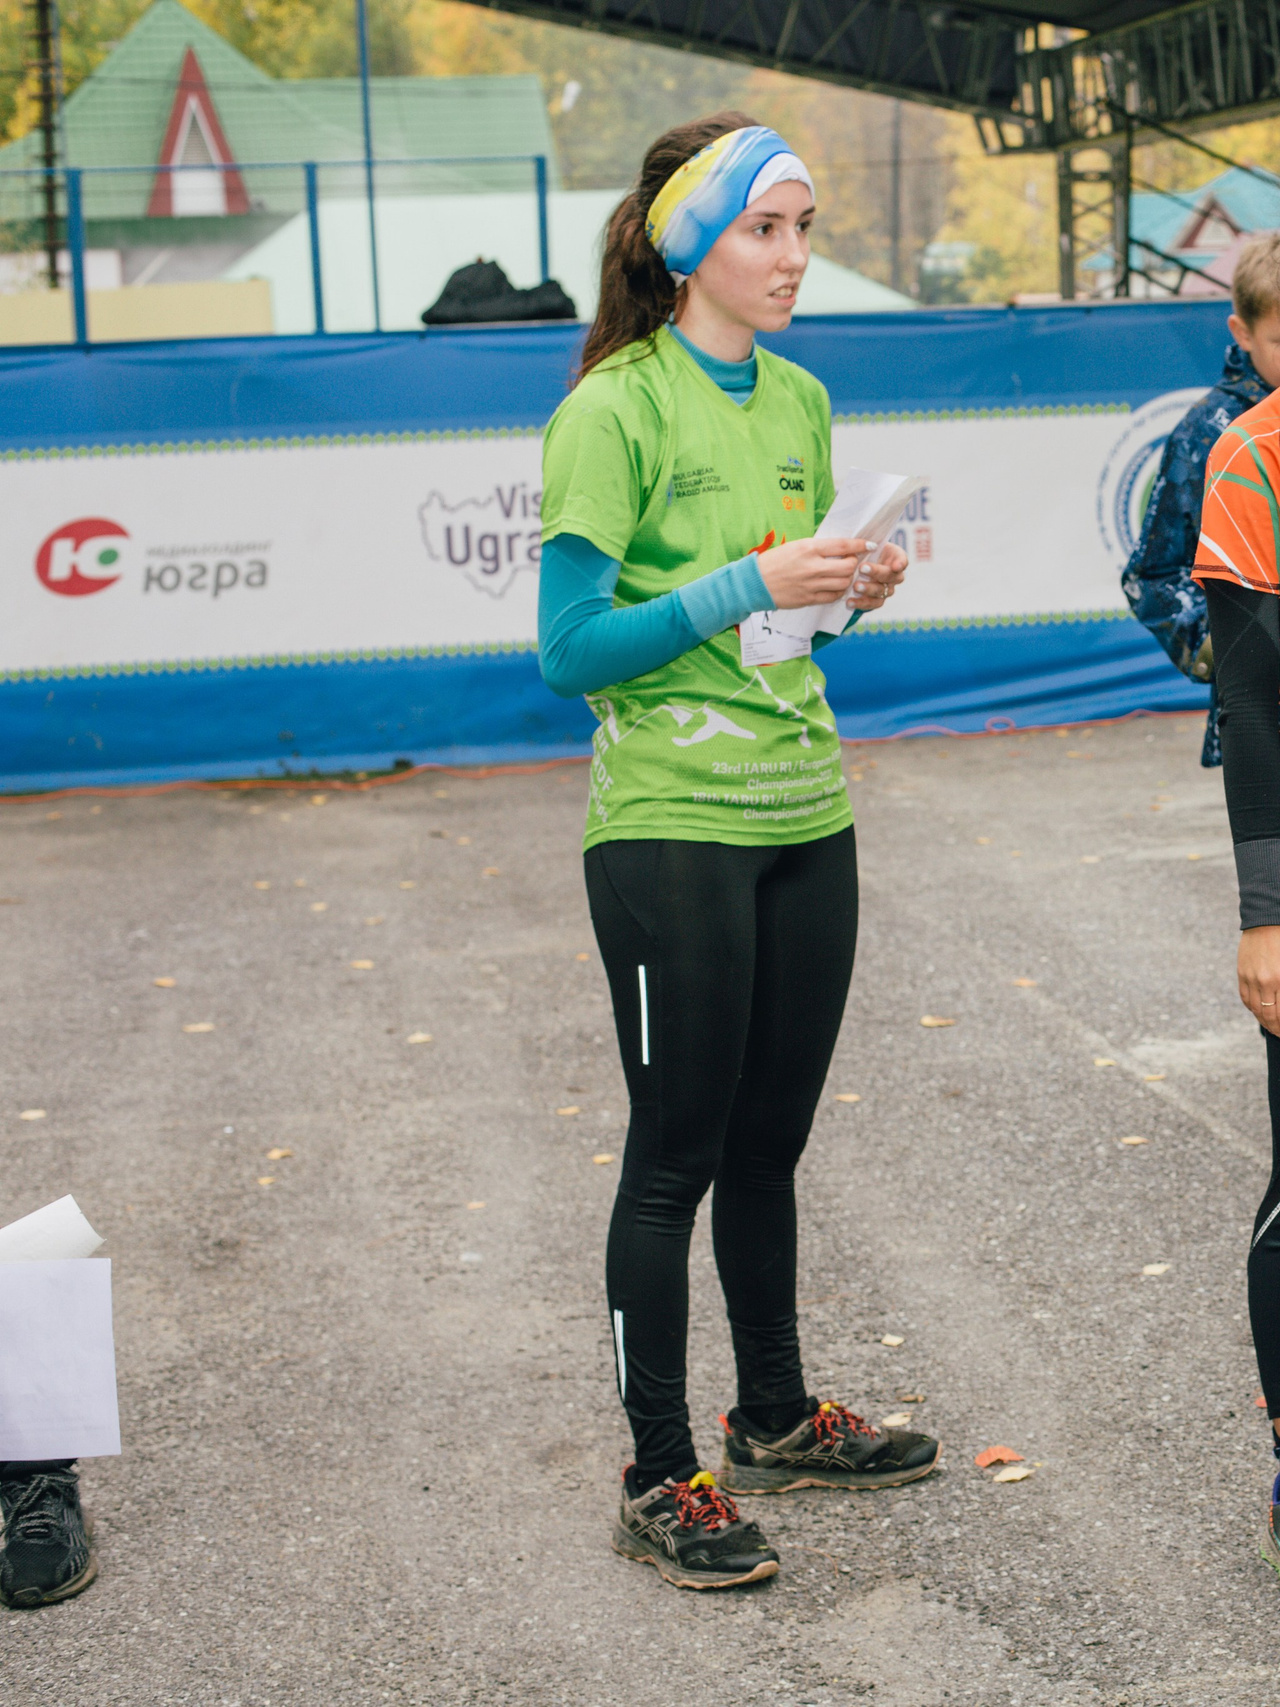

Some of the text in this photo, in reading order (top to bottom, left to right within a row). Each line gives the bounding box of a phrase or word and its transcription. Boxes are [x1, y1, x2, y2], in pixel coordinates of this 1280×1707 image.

[444, 523, 541, 575] Ugra
[712, 762, 741, 774] 23rd
[744, 762, 778, 774] IARU
[723, 792, 760, 806] IARU
